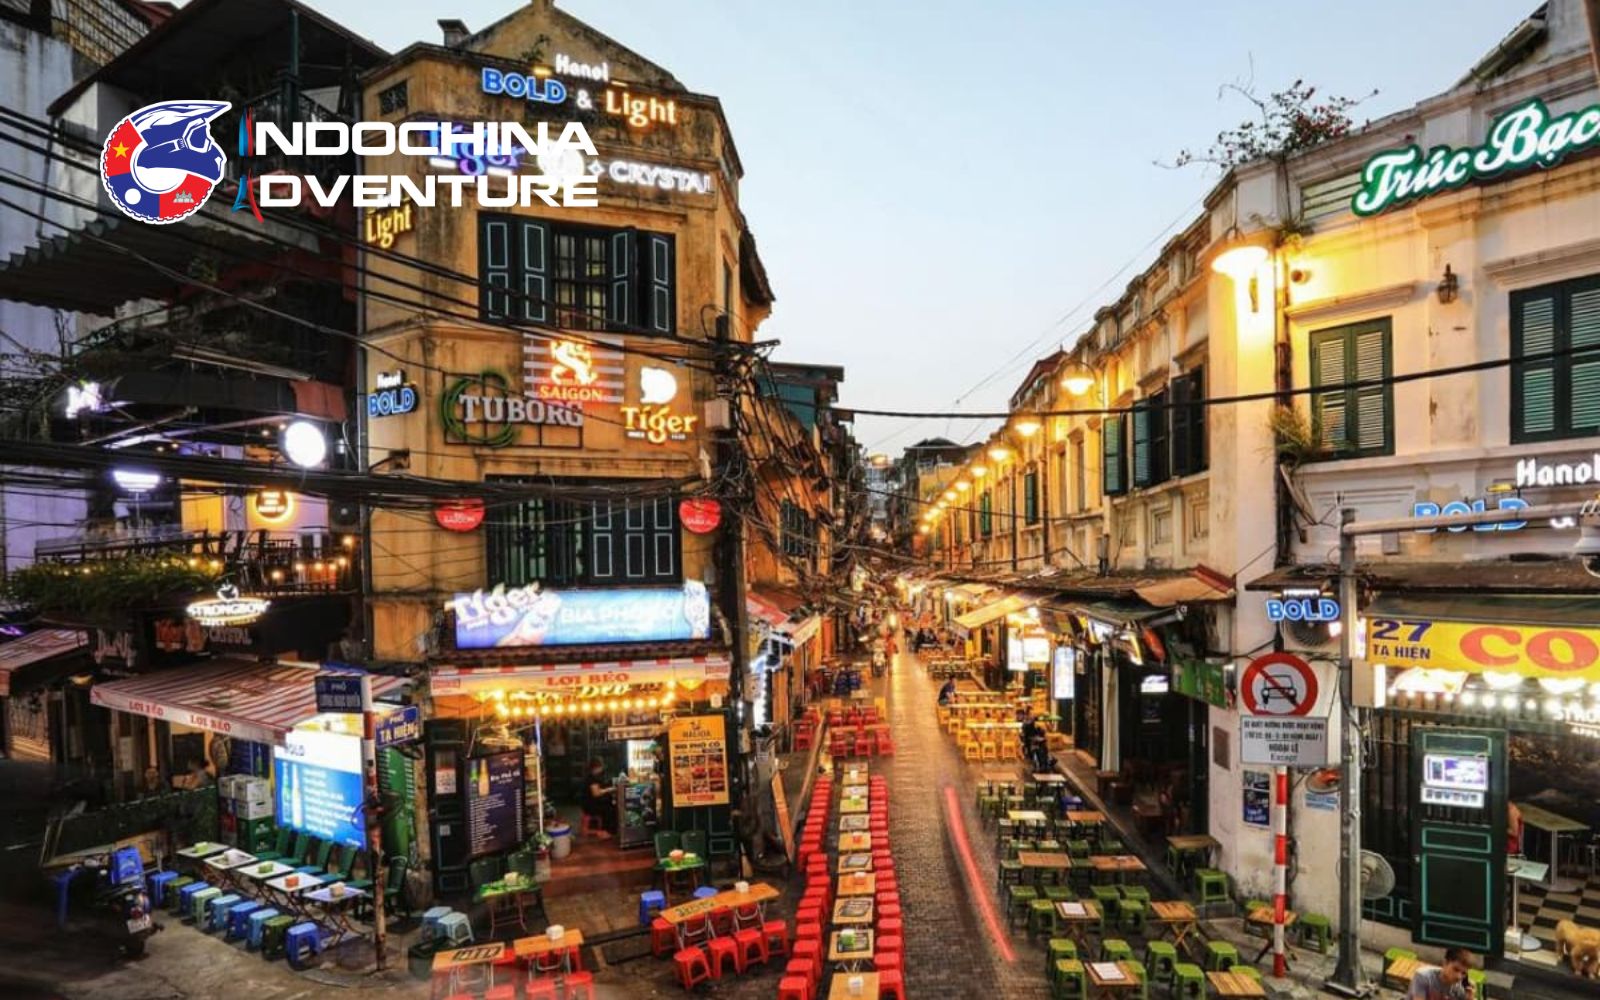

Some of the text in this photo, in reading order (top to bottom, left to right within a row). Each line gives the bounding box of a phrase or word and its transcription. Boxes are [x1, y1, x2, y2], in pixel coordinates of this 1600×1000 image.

[555, 53, 609, 83] Hanoi
[482, 67, 677, 128] BOLD & Light
[1355, 148, 1470, 212] Trúc
[367, 203, 411, 249] Light
[368, 387, 415, 417] BOLD
[540, 384, 602, 402] SAIGON
[460, 395, 583, 427] TUBORG
[1266, 599, 1340, 621] BOLD
[1372, 619, 1433, 642] 27
[1460, 626, 1599, 672] CO
